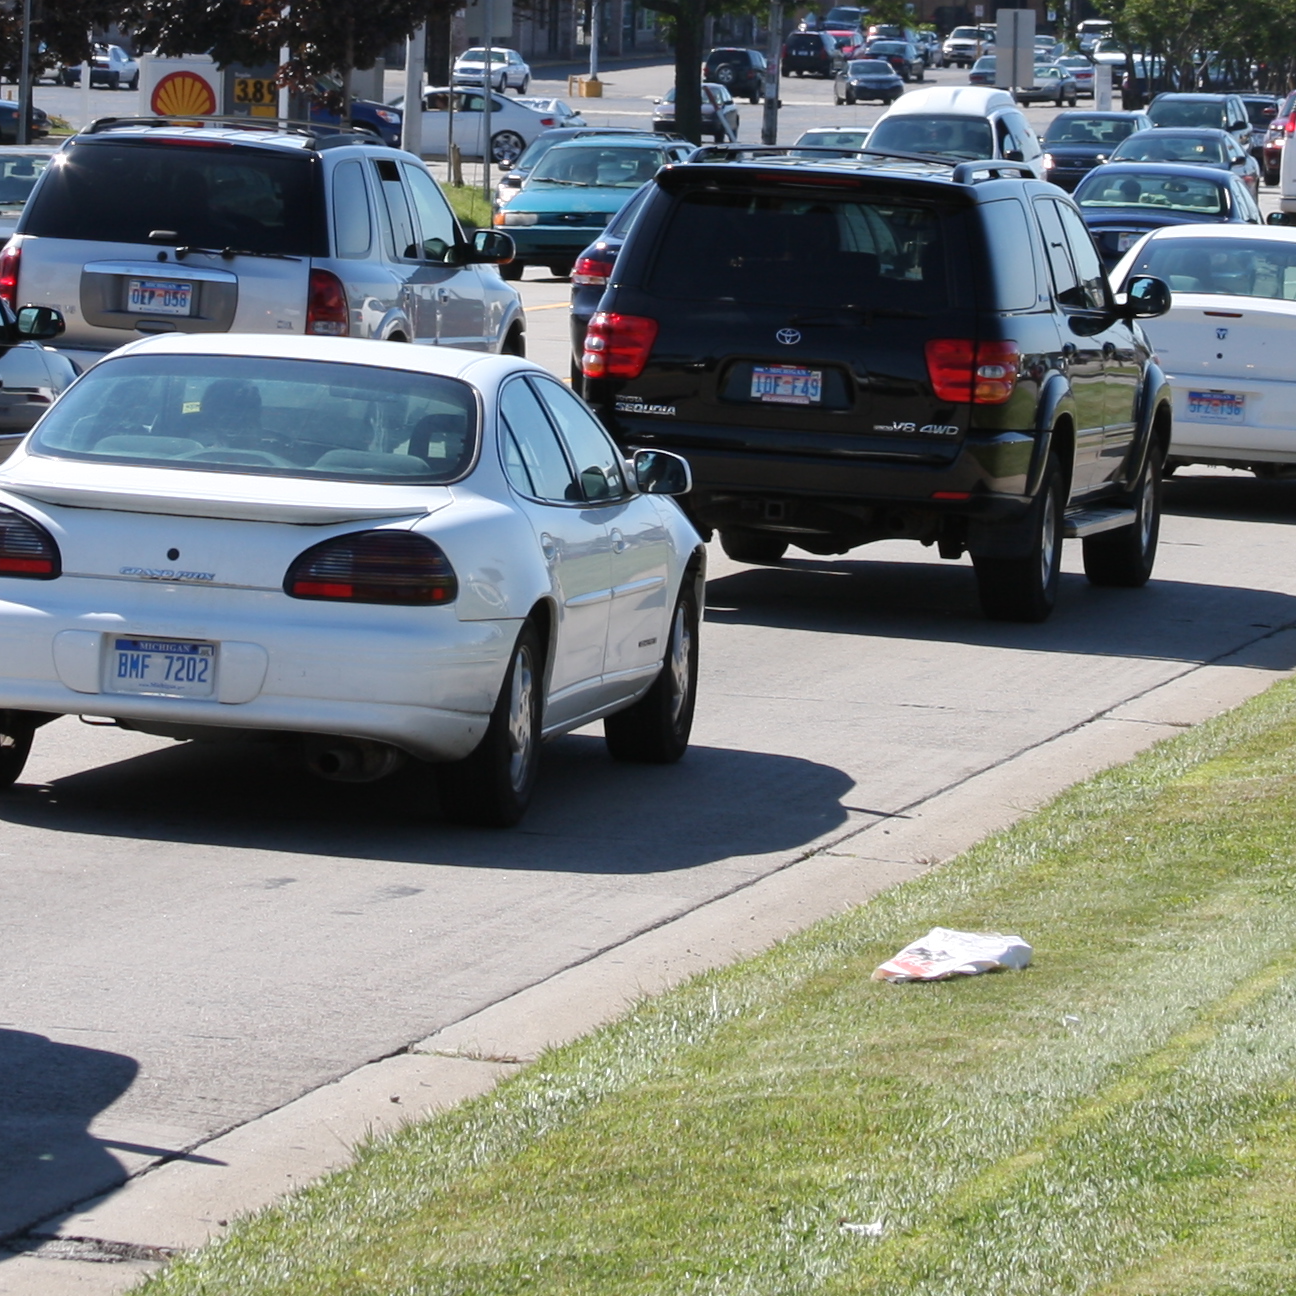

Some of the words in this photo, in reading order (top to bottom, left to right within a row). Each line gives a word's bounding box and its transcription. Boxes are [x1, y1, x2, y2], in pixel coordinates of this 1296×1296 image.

[615, 401, 676, 416] SEQUOIA
[893, 421, 916, 433] V8
[919, 424, 959, 435] 4WD
[139, 641, 191, 653] MICHIGAN
[117, 652, 152, 679] BMF
[164, 655, 210, 683] 7202
